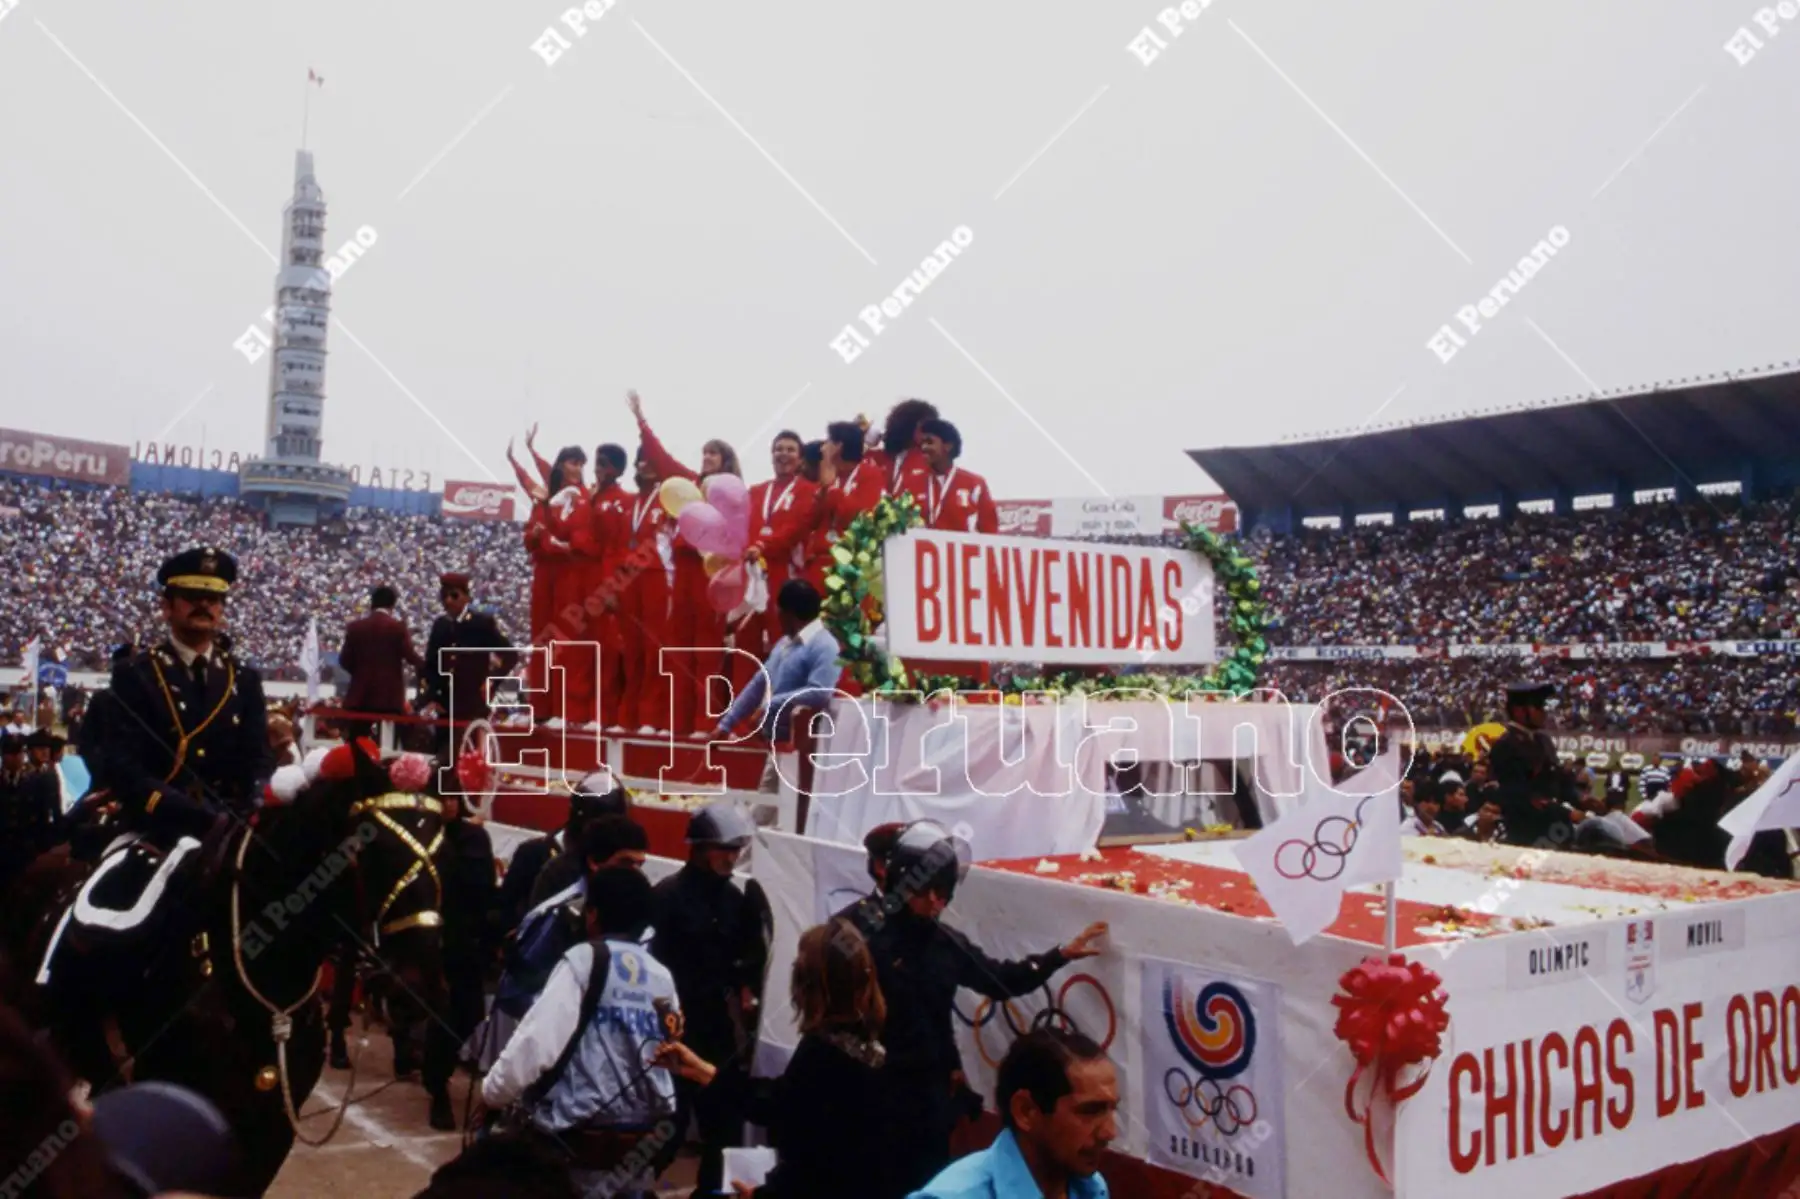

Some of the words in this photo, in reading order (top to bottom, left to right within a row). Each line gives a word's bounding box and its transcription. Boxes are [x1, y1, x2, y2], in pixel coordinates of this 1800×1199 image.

[915, 538, 1183, 652] BIENVENIDAS
[1686, 920, 1723, 948] MOVIL
[1529, 941, 1590, 975] OLIMPIC
[596, 1005, 662, 1038] PRENS
[1449, 1018, 1634, 1174] CHICAS
[1653, 1002, 1705, 1118] DE
[1726, 985, 1800, 1098] ORO
